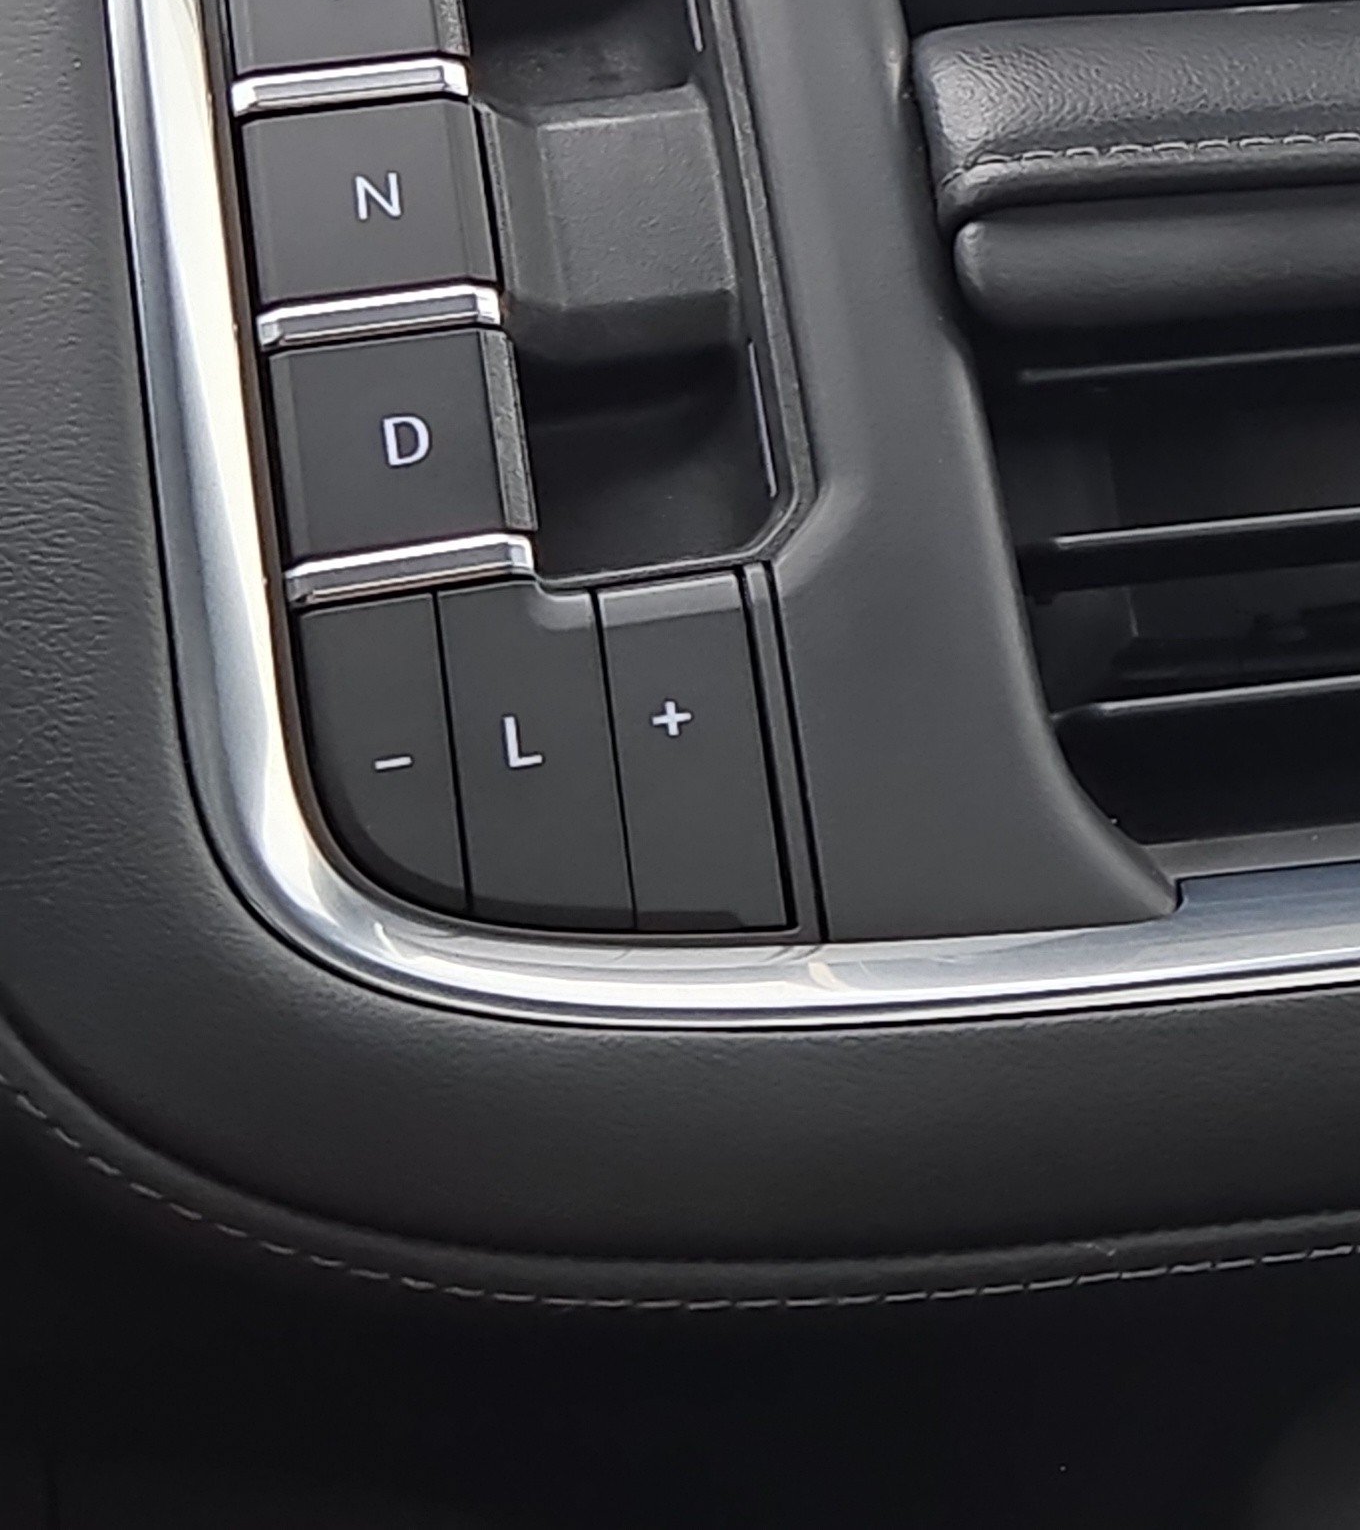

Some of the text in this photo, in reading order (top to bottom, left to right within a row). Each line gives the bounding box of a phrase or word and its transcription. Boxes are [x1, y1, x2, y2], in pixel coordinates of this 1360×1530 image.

[354, 172, 402, 220] N
[382, 416, 431, 467] D
[504, 715, 543, 768] L
